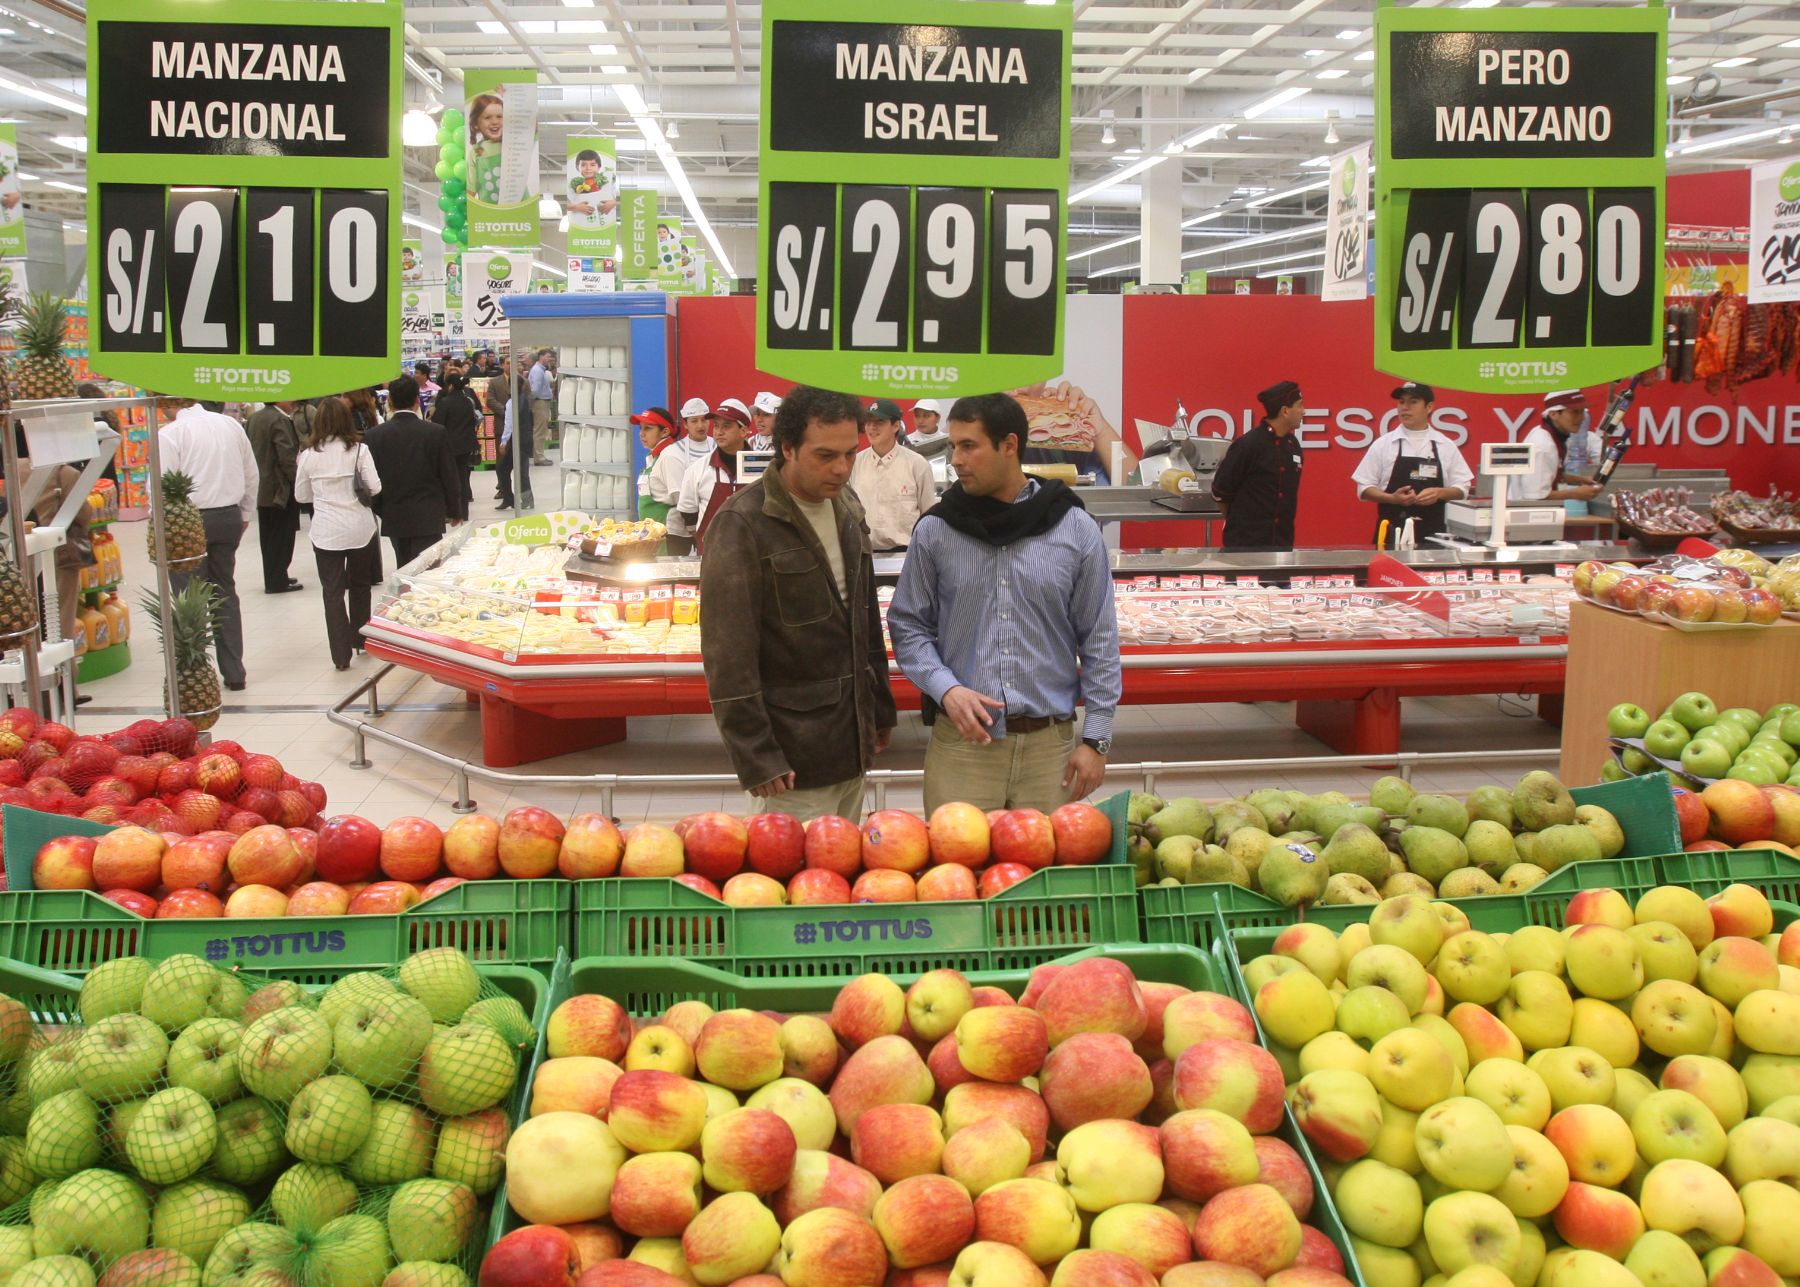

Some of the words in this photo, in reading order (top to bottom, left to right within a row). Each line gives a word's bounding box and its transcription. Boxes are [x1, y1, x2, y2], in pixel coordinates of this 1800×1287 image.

[152, 41, 346, 83] MANZANA
[836, 43, 1028, 84] MANZANA
[1478, 49, 1570, 85] PERO
[150, 100, 346, 141] NACIONAL
[864, 102, 998, 142] ISRAEL
[1435, 106, 1611, 142] MANZANO
[486, 222, 532, 232] TOTTUS
[578, 238, 612, 247] TOTTUS
[634, 195, 646, 267] OFERTA
[107, 228, 162, 334] S/.
[774, 224, 830, 331] S/.
[1399, 232, 1454, 333] S/.
[212, 367, 291, 385] TOTTUS
[880, 365, 959, 382] TOTTUS
[1496, 361, 1568, 377] TOTTUS
[1493, 407, 1535, 443] Y
[508, 525, 548, 538] Oferta
[231, 929, 346, 957] TOTTUS
[819, 918, 933, 942] TOTTUS
